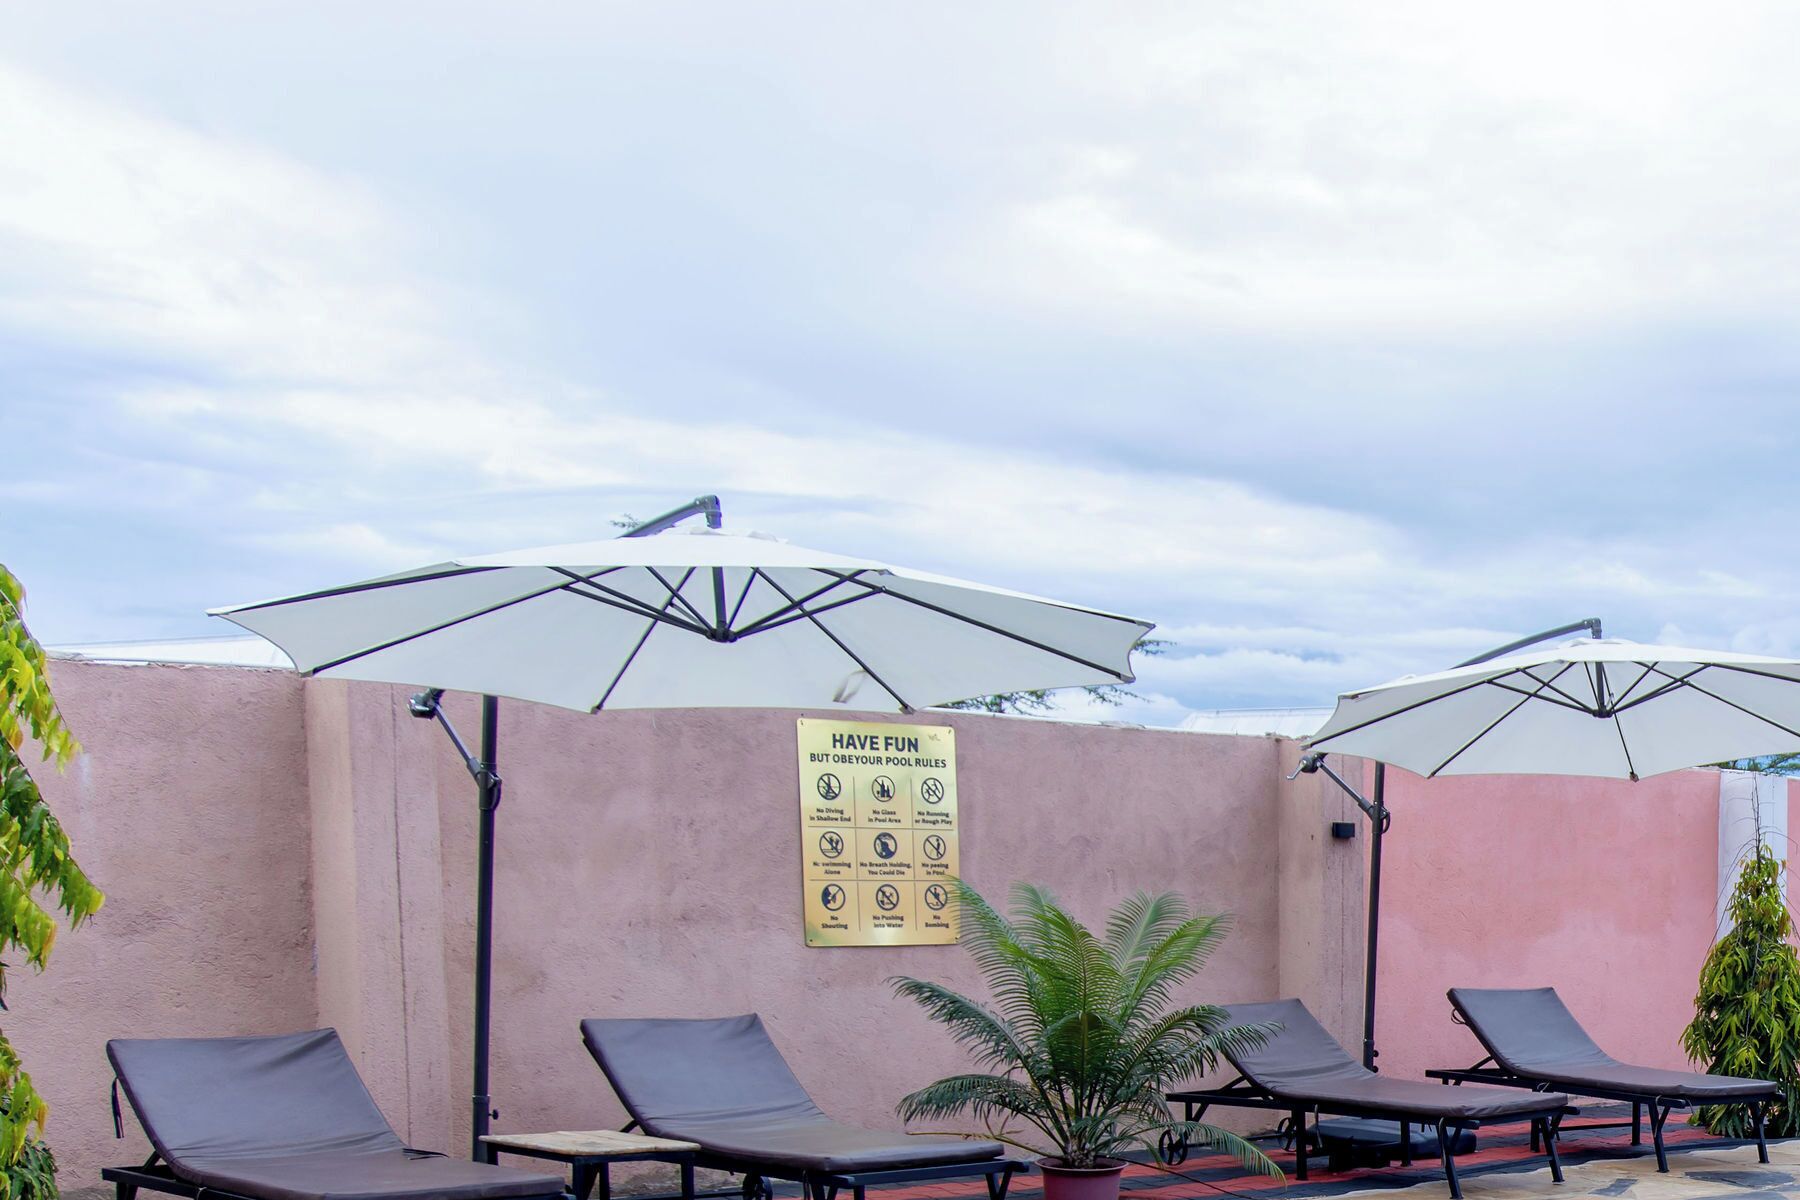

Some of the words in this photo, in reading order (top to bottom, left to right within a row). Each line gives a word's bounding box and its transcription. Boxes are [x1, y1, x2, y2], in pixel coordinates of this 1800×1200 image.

[832, 733, 880, 751] HAVE
[884, 736, 919, 753] FUN
[809, 753, 830, 763] BUT
[885, 756, 913, 767] POOL
[915, 758, 947, 768] RULES
